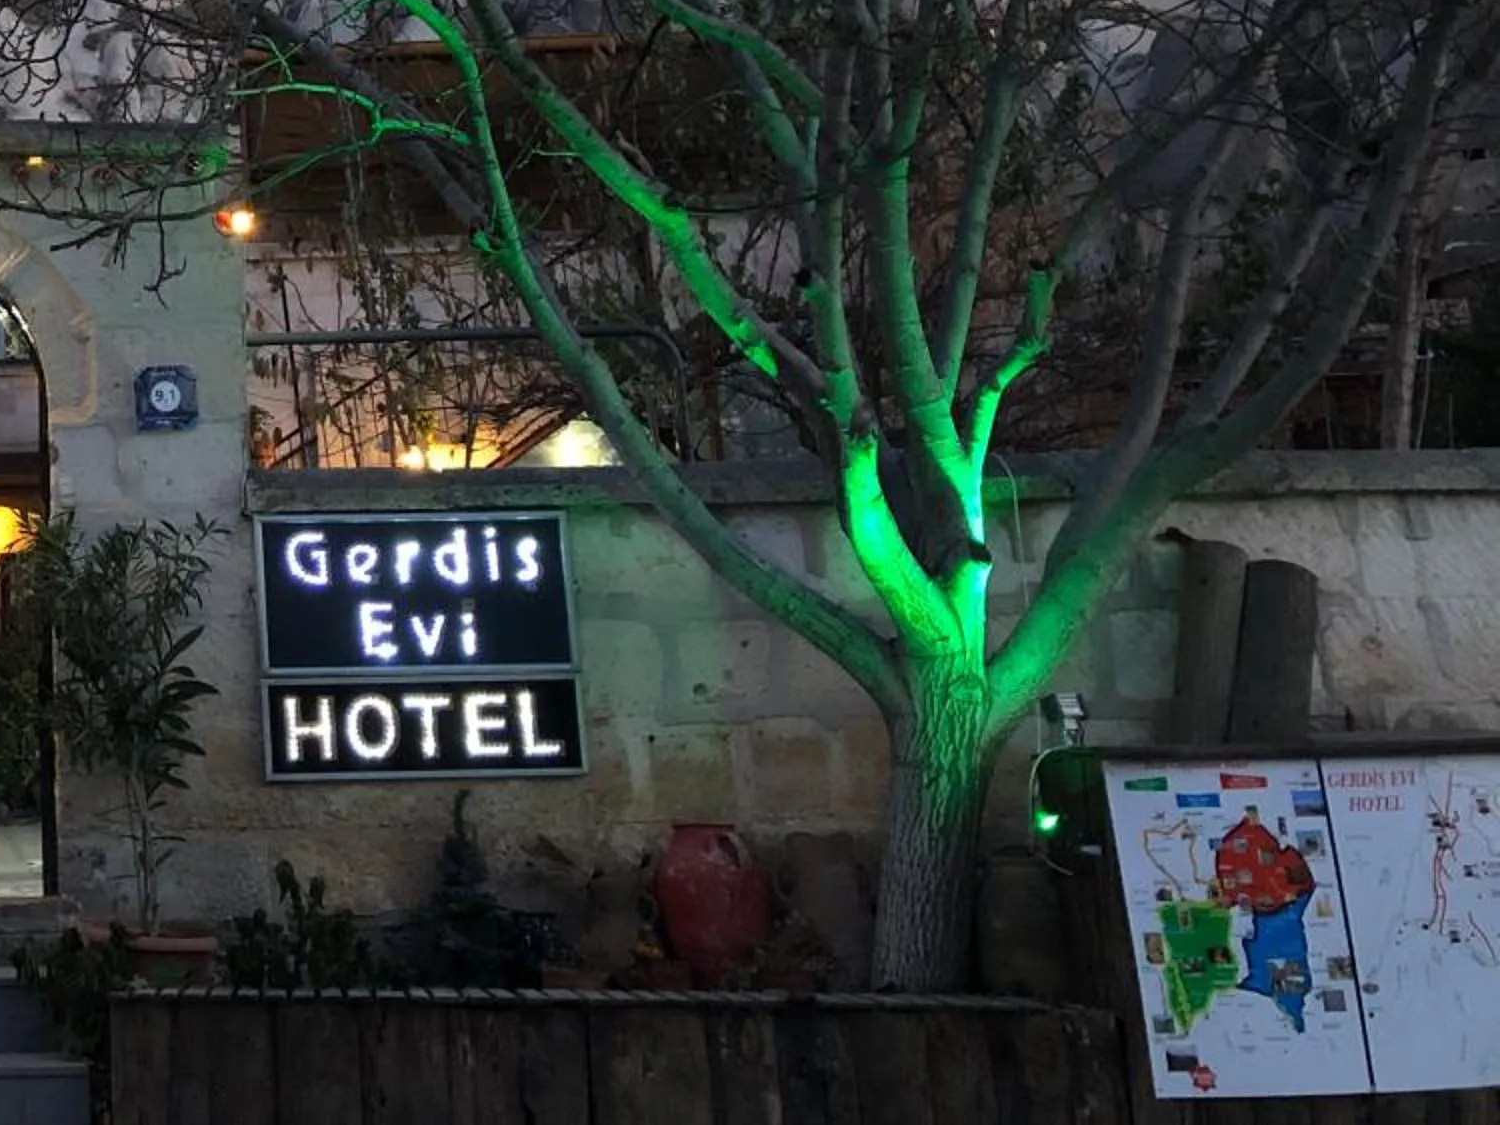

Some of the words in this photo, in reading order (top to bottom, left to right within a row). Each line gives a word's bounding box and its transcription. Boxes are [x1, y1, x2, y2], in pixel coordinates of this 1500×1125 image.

[359, 602, 477, 660] Evi
[283, 691, 562, 762] HOTEL
[1349, 795, 1404, 812] HOTEL
